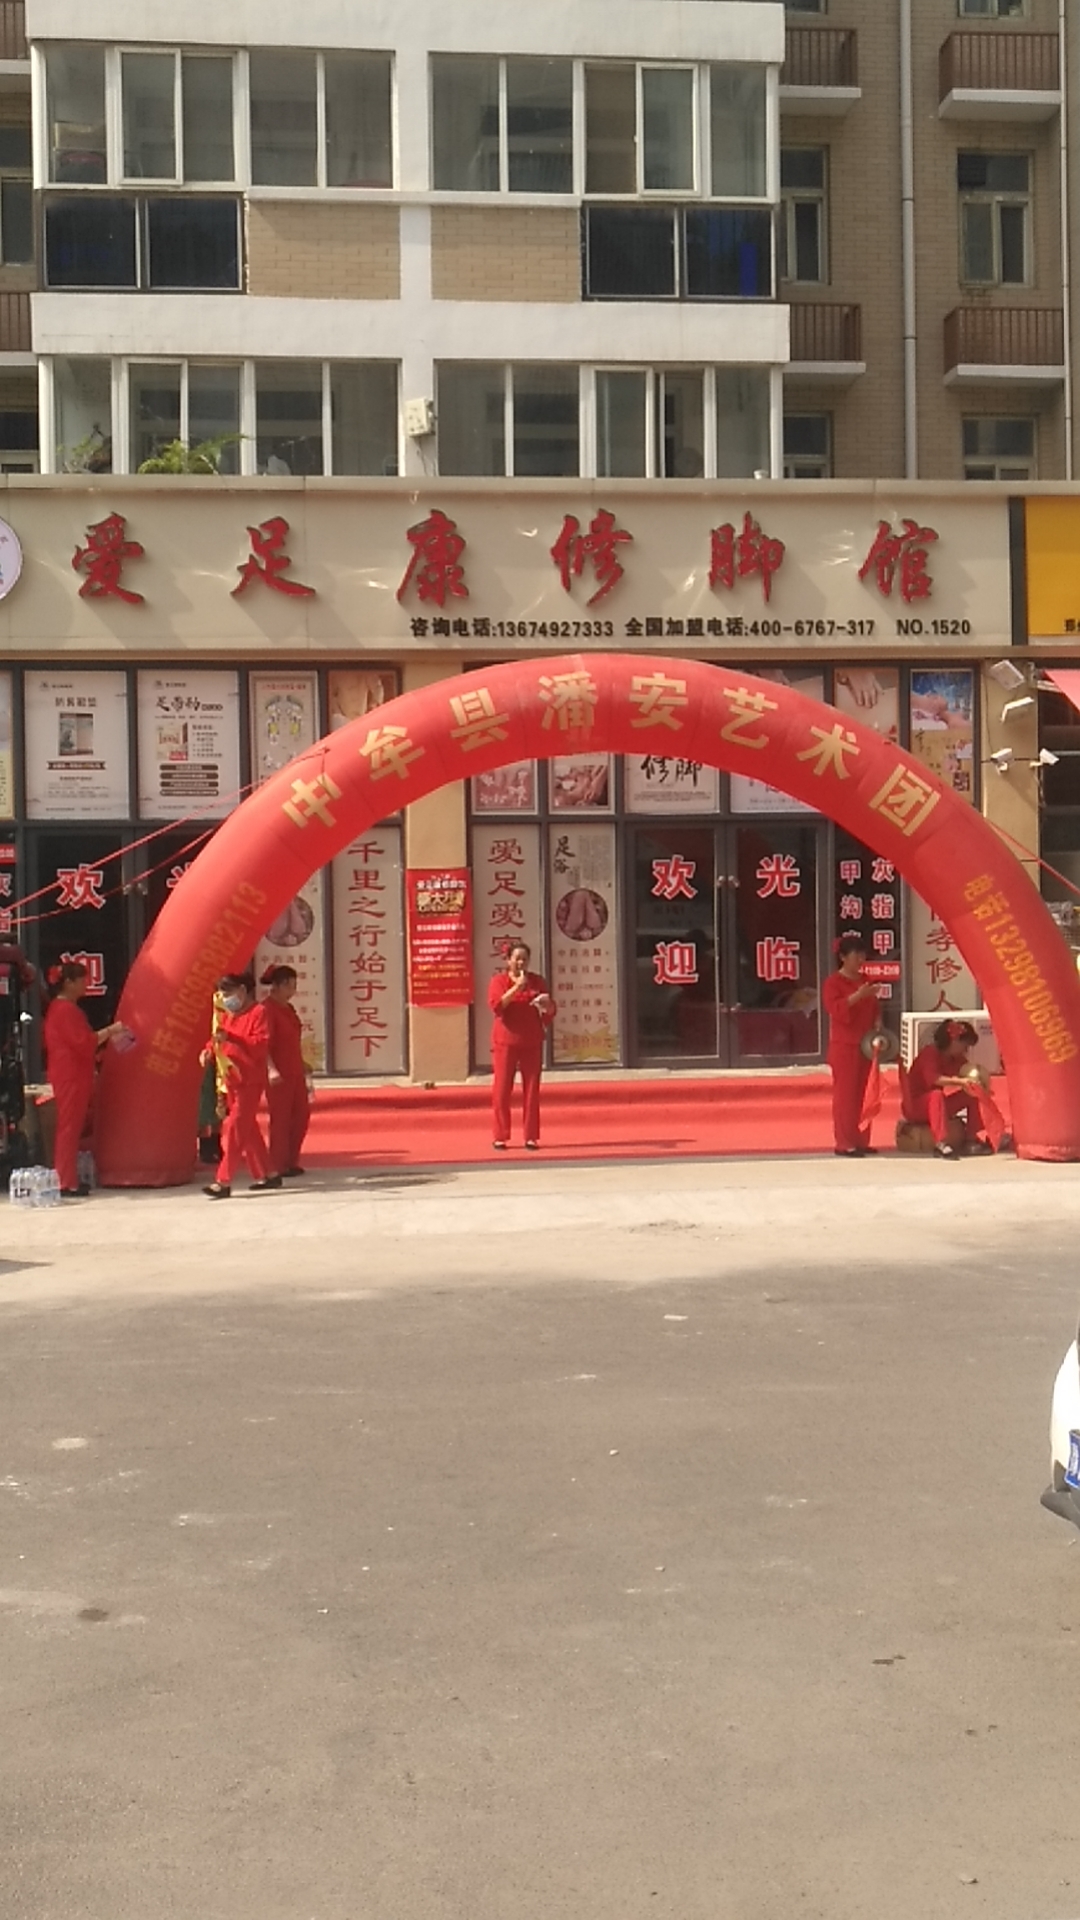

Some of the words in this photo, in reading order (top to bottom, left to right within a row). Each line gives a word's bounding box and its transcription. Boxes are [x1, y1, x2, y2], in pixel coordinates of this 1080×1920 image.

[72, 509, 939, 607] 爱足康修脚馆
[411, 617, 613, 637] 咨询电话:13674927333
[625, 617, 875, 637] 全国加盟电话:400-6767-317
[897, 618, 970, 636] NO.1520
[282, 672, 941, 837] 中牟县潘安艺术团
[348, 841, 388, 1058] 千里之行始于足下
[651, 855, 699, 985] 欢迎
[756, 854, 801, 982] 光临
[840, 860, 863, 938] 甲沟
[926, 908, 963, 1012] 孝修人
